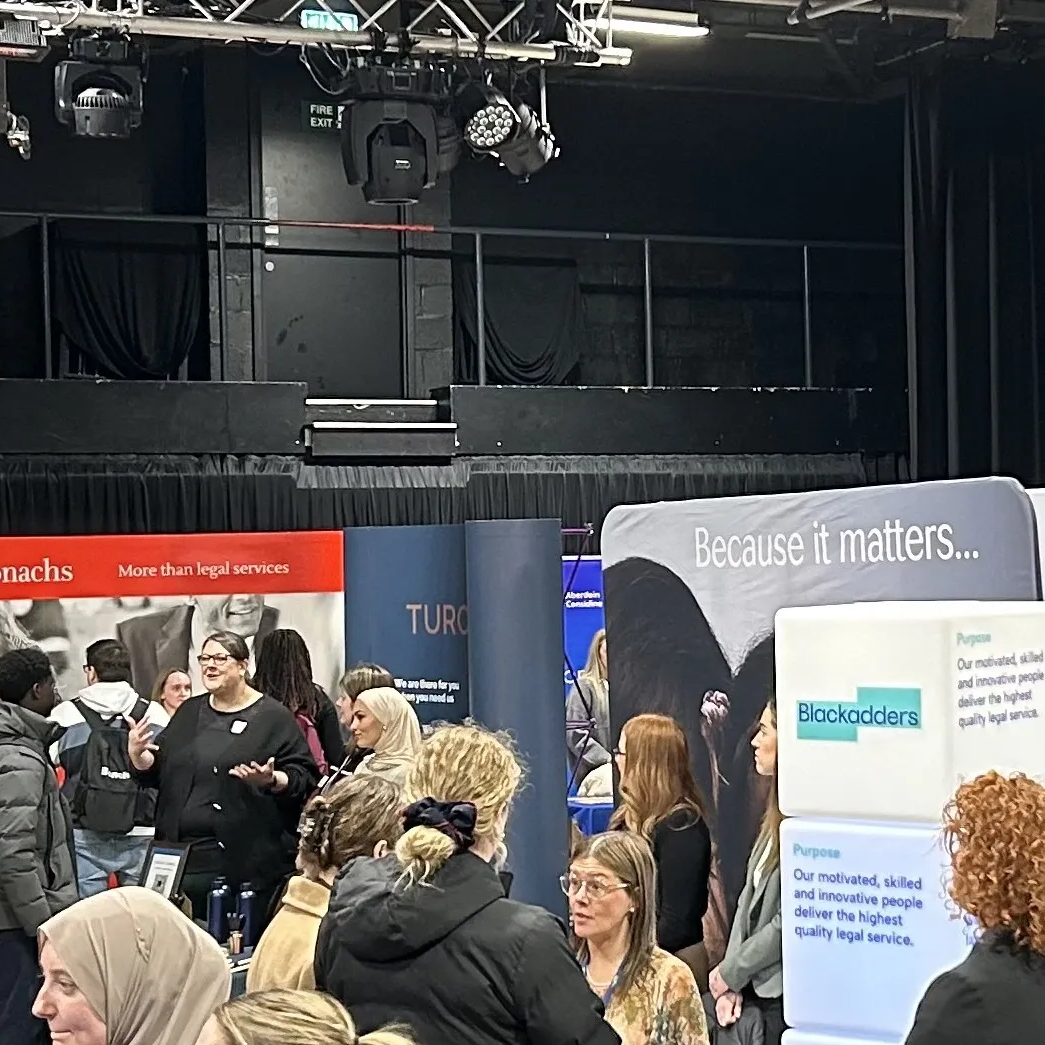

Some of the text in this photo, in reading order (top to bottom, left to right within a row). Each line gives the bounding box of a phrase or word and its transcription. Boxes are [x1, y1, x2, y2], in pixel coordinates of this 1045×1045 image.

[310, 104, 333, 115] FIRE
[310, 117, 333, 128] EXIT
[695, 519, 980, 569] Because it matters...
[118, 564, 157, 577] More
[160, 562, 193, 577] than
[197, 561, 230, 579] legal
[233, 561, 290, 575] services
[406, 603, 468, 635] TURC
[957, 657, 973, 670] Our
[1020, 650, 1044, 664] skilled
[394, 678, 459, 692] We are there for you
[958, 670, 1044, 690] and innovative people
[416, 694, 429, 704] you
[429, 693, 446, 703] need
[958, 690, 1032, 708] deliver the highest
[798, 702, 919, 726] Blackadders
[958, 712, 986, 730] quality
[988, 709, 1008, 725] legal
[793, 843, 841, 860] Purpose
[793, 868, 922, 890] Our motivated, skilled
[794, 888, 923, 911] and innovative people
[794, 905, 903, 927] deliver the highest
[795, 925, 914, 947] quality legal service.
